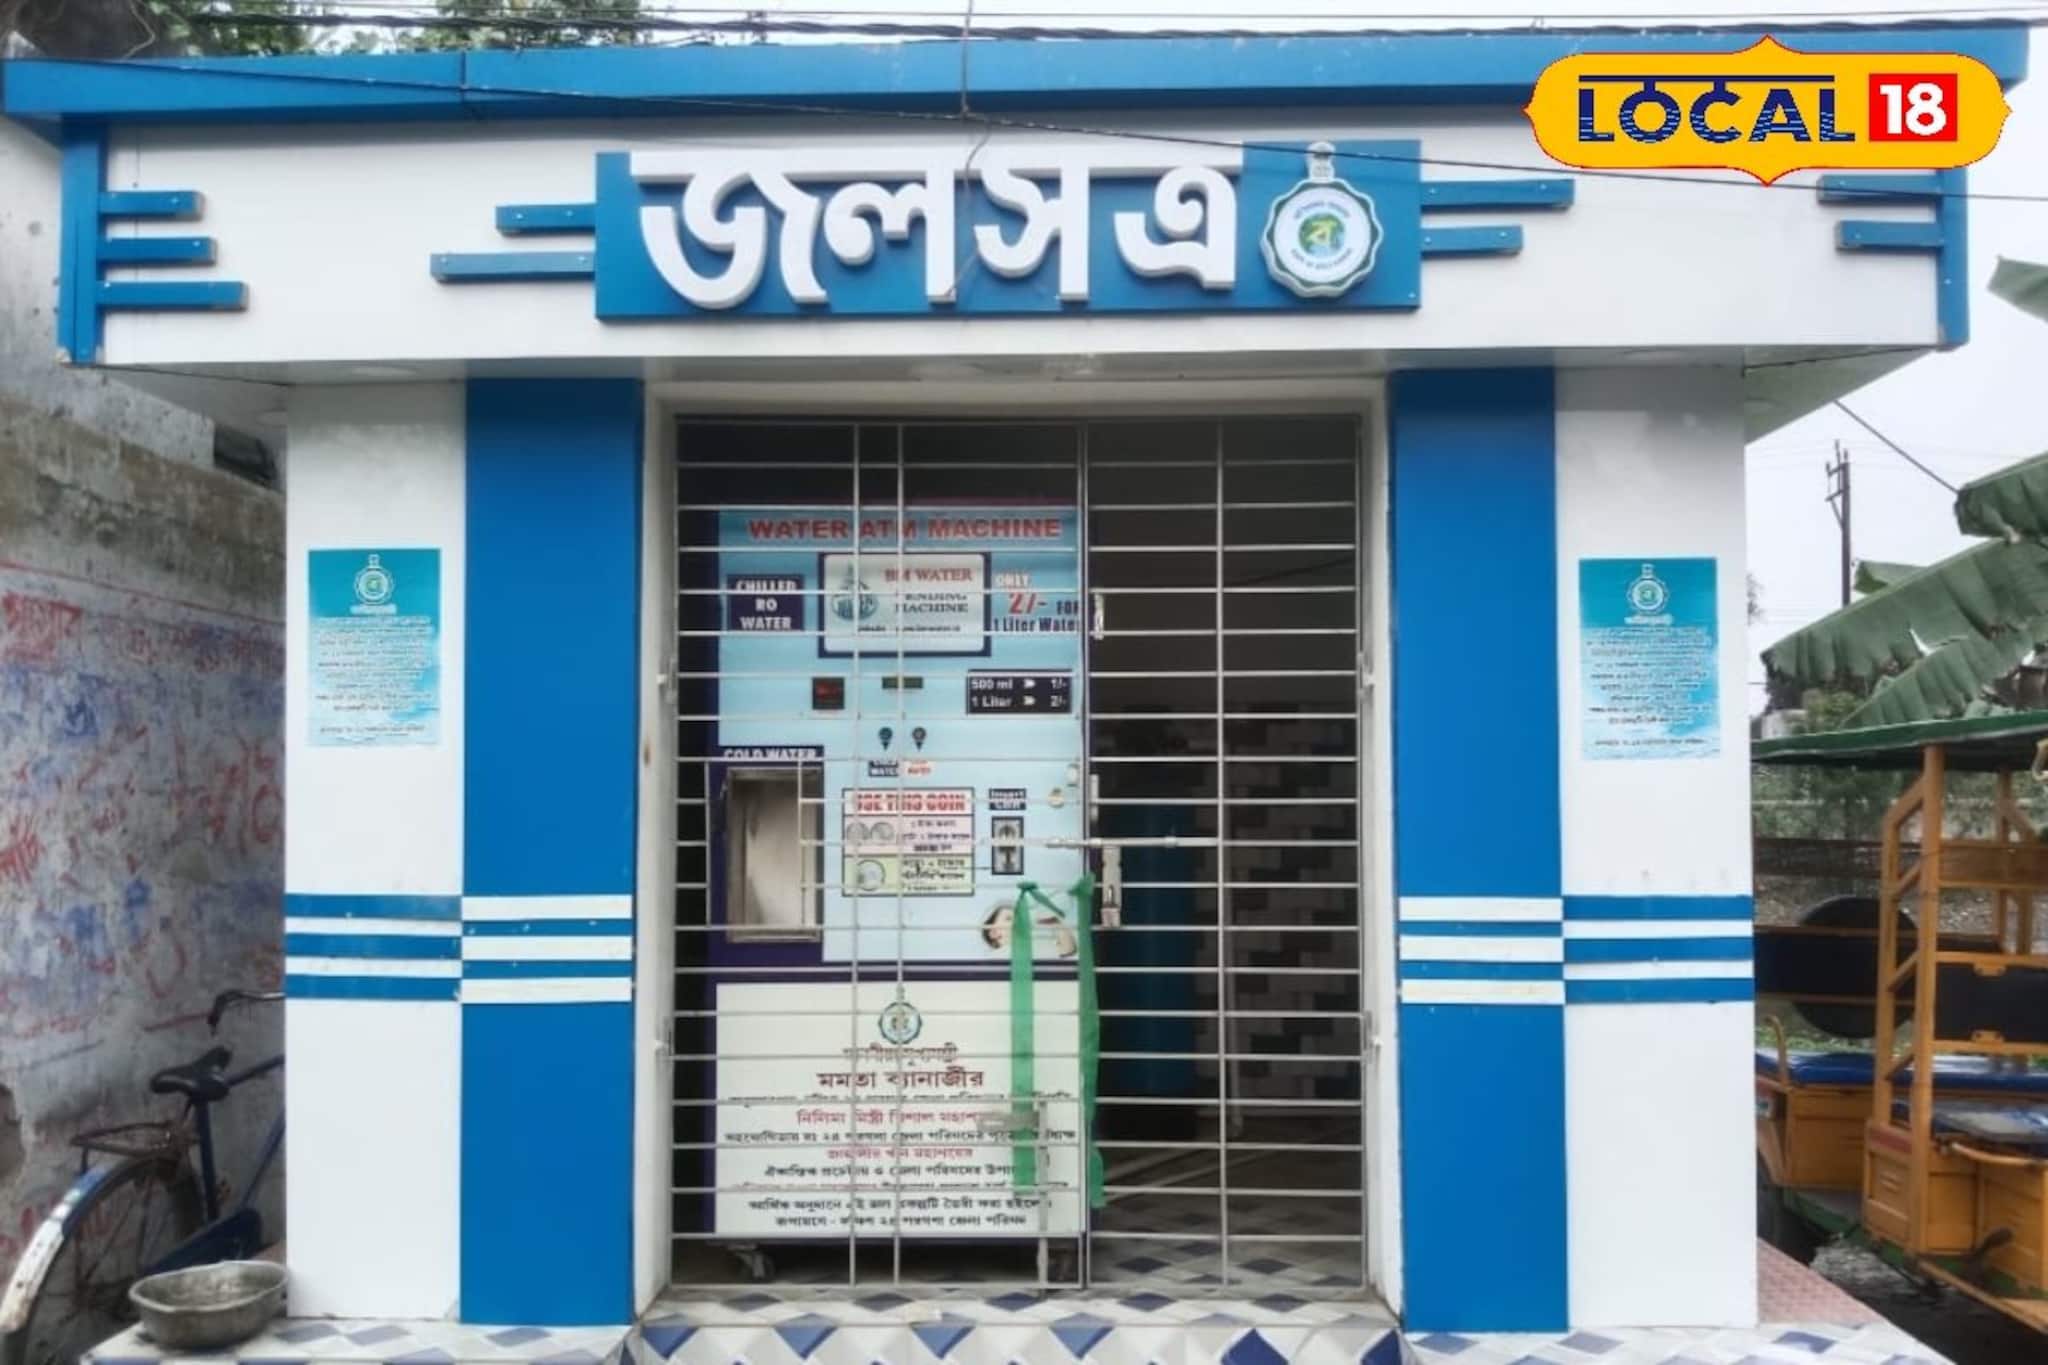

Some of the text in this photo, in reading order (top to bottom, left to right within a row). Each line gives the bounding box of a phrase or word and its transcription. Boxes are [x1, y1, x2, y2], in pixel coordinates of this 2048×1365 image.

[630, 141, 1242, 309] জলসত্র
[749, 517, 1064, 540] WATER ATM MACHINE
[916, 566, 973, 582] WATER
[756, 597, 778, 612] RO
[741, 617, 792, 631] WATER
[1003, 616, 1035, 633] Liter
